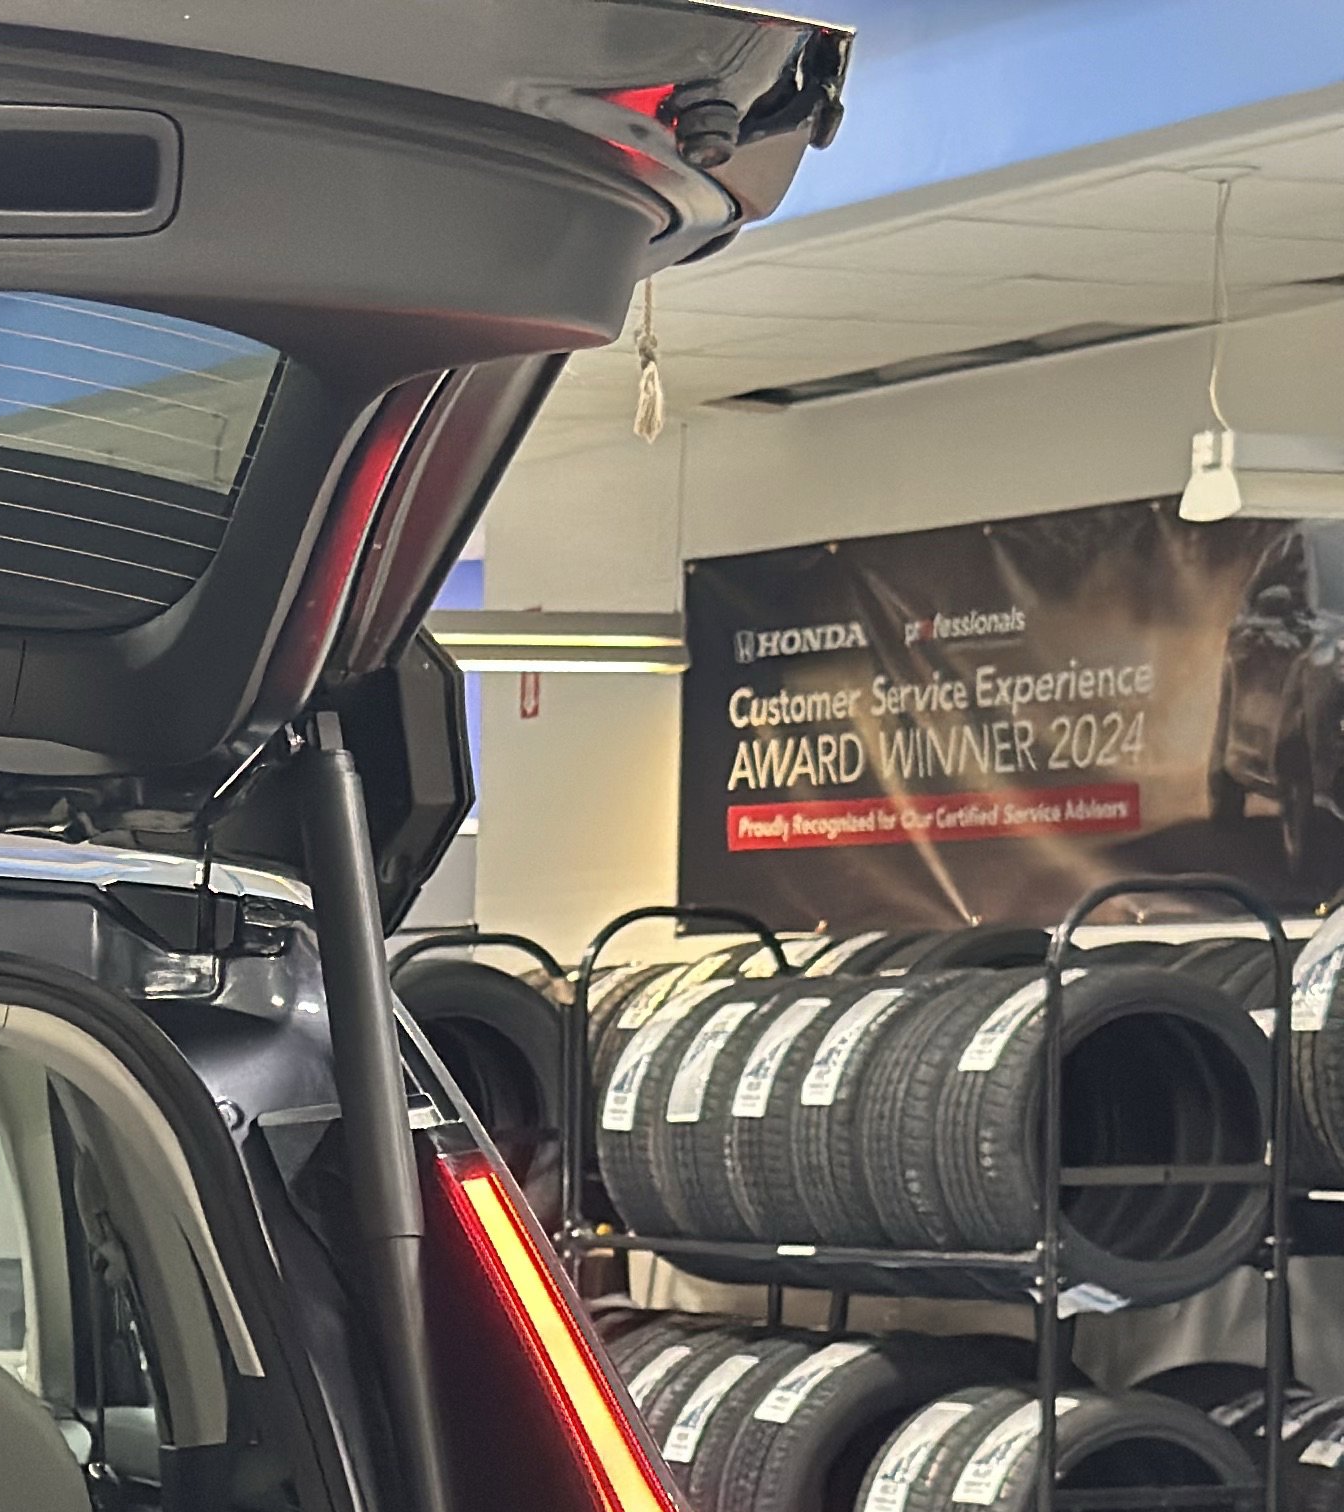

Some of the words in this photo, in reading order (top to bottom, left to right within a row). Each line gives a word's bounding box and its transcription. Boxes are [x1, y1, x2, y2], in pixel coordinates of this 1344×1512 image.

[756, 622, 868, 658] HONDA
[905, 607, 1026, 647] professionals
[728, 686, 862, 728] Customer
[870, 671, 968, 716] Service
[975, 657, 1155, 715] Experience
[727, 733, 863, 791] AWARD
[878, 719, 1038, 780] WINNER
[1048, 711, 1145, 770] 2024
[738, 814, 790, 842] Proudly
[792, 811, 875, 840] Recognized
[900, 808, 932, 830] Our
[935, 803, 999, 829] Certified
[1003, 802, 1062, 825] Service
[1064, 798, 1129, 821] Advisors
